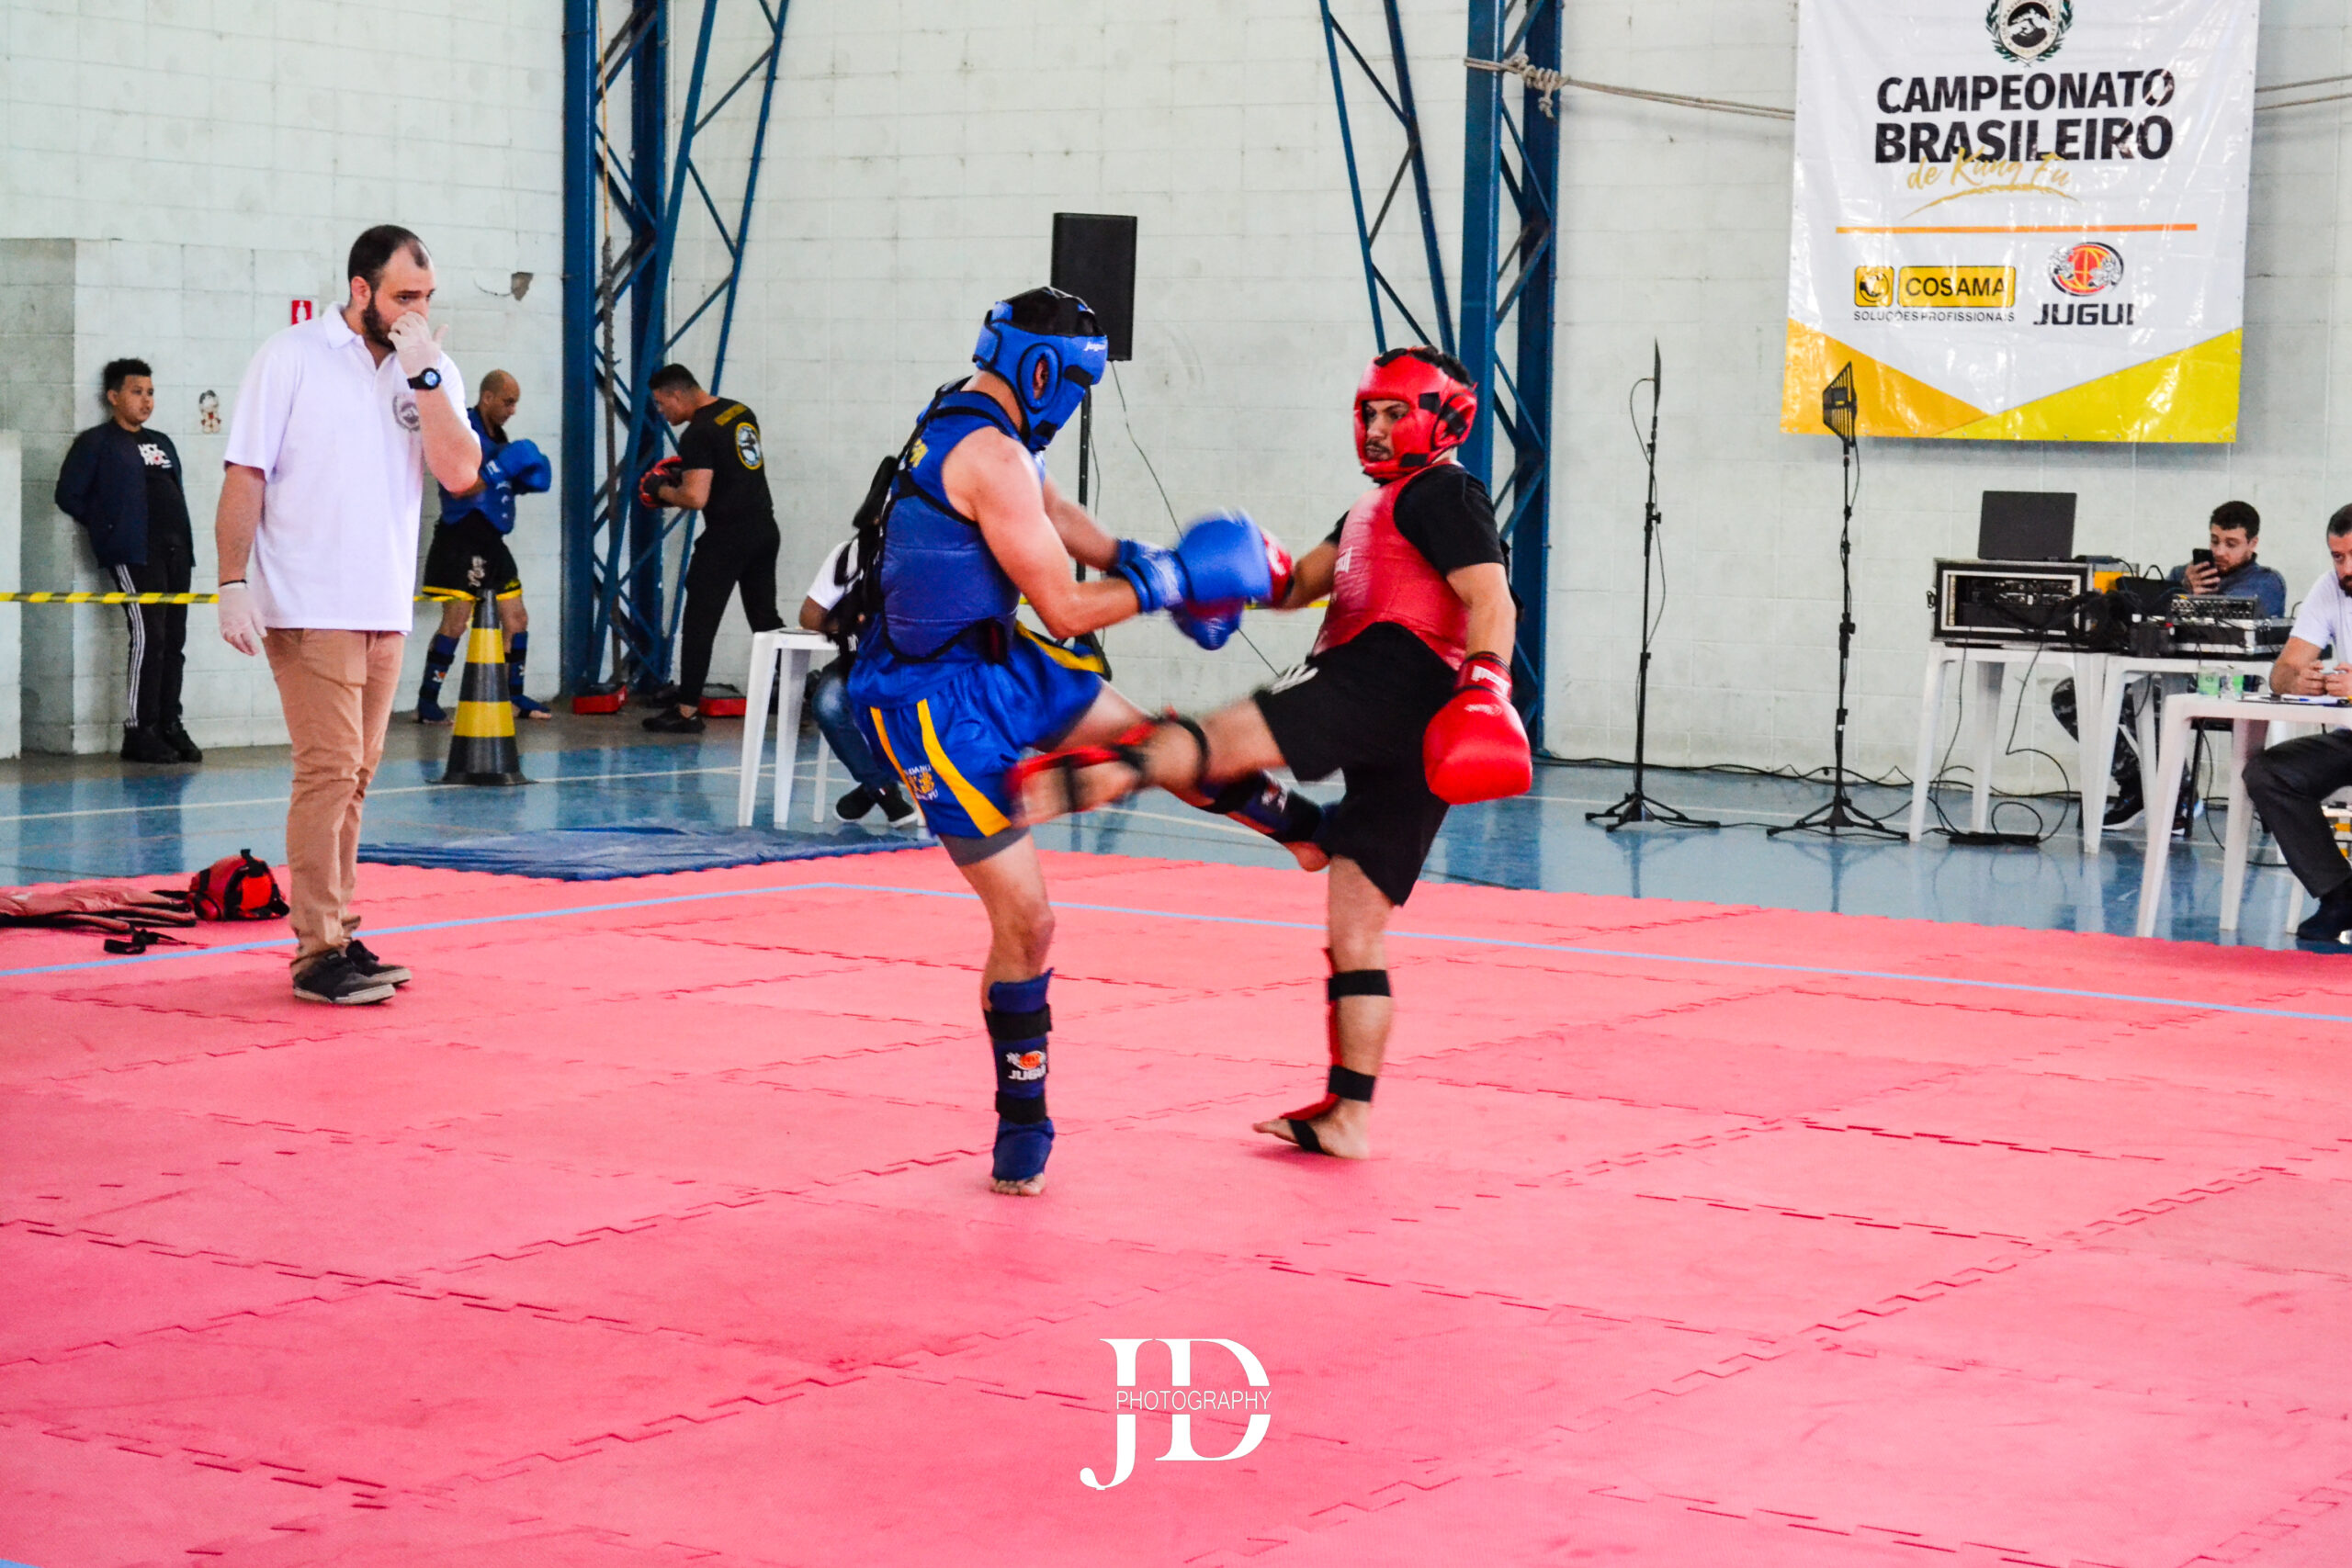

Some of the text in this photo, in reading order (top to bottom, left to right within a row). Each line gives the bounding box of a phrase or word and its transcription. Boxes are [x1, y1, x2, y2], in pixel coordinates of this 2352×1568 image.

[1876, 67, 2176, 114] CAMPEONATO
[1874, 114, 2175, 164] BRASILEIRO
[1906, 146, 2071, 189] de Kung Fu
[1905, 276, 2007, 297] COSAMA
[2032, 302, 2135, 326] JUGUI
